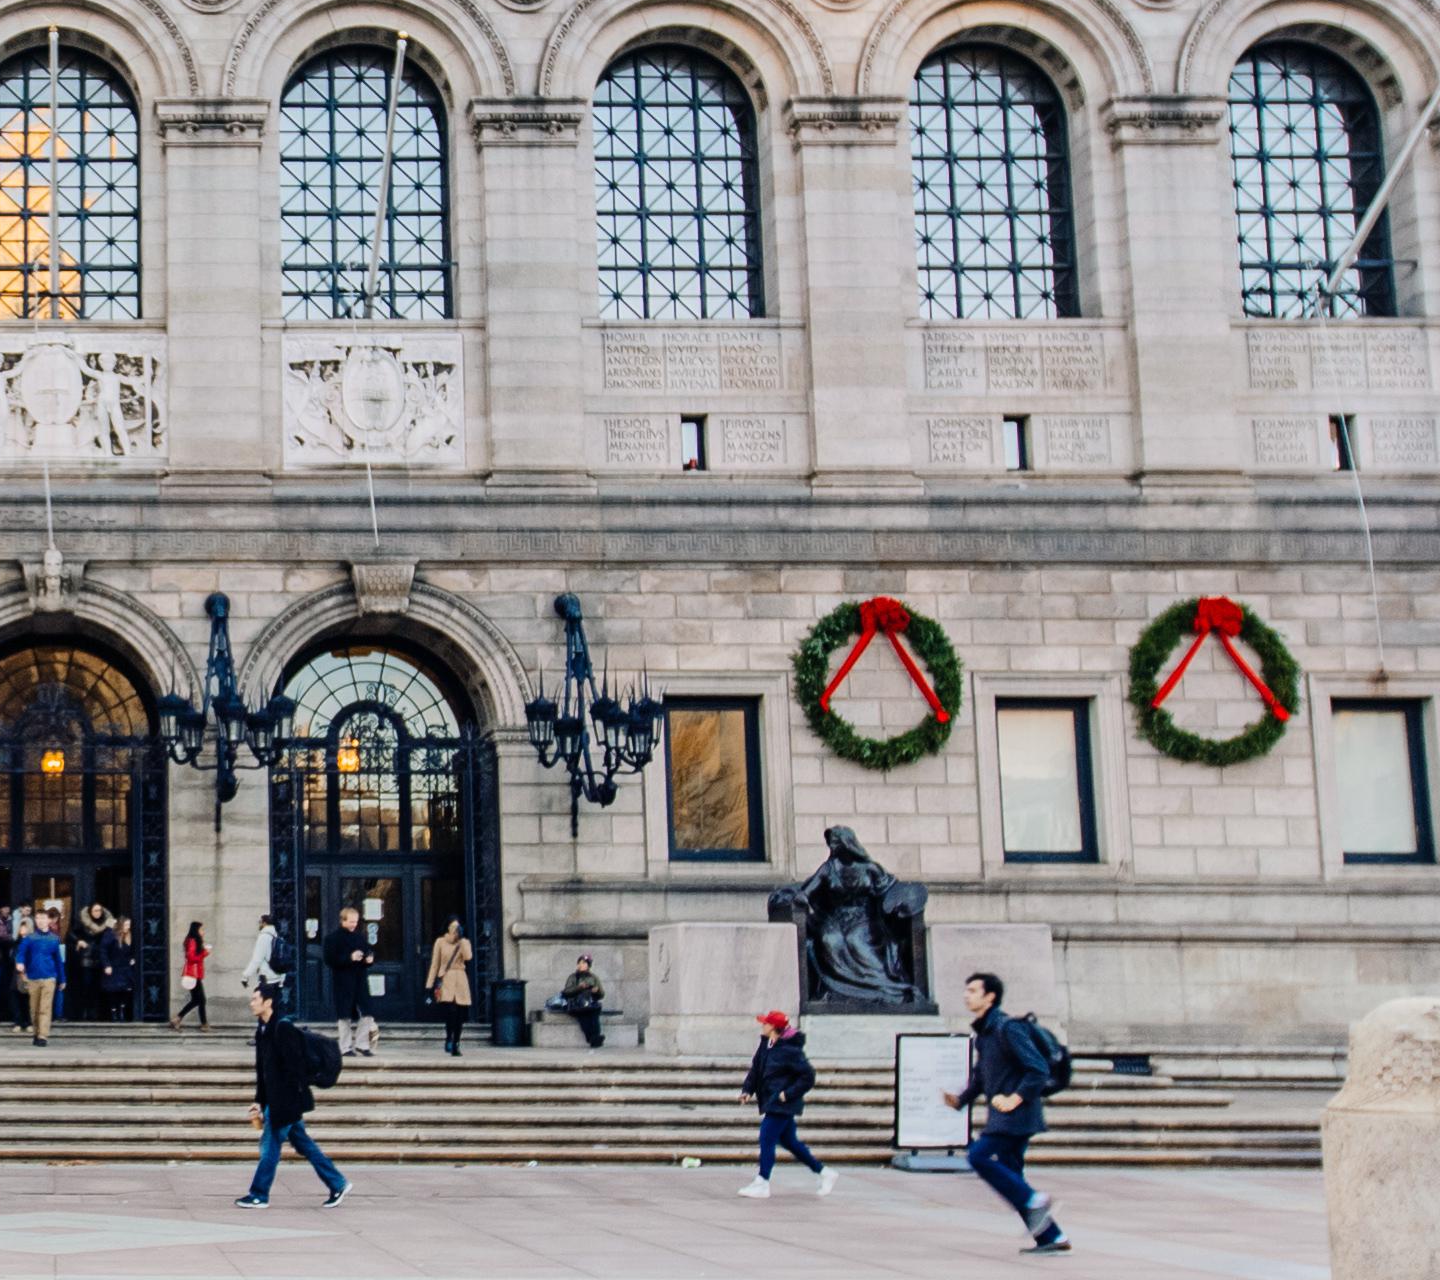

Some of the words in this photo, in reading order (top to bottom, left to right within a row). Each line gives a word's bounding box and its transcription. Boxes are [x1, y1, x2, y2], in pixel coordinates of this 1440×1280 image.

[606, 333, 646, 342] HOMER
[667, 333, 712, 342] HORACE
[721, 332, 763, 342] DANTE
[927, 333, 975, 342] ADDISON
[1044, 332, 1090, 342] ARNOLD
[607, 344, 650, 354] SAPPHO
[668, 345, 699, 353] OVID
[723, 344, 762, 353] TASSO
[928, 356, 959, 365] SWIFT
[929, 380, 963, 389] LAMB
[609, 419, 651, 429] HESIOD
[932, 419, 985, 428] JOHNSON
[726, 441, 779, 451] MANZONI
[933, 441, 983, 451] CAXTON
[727, 453, 774, 462] SPINOZA
[933, 453, 966, 462] AMES
